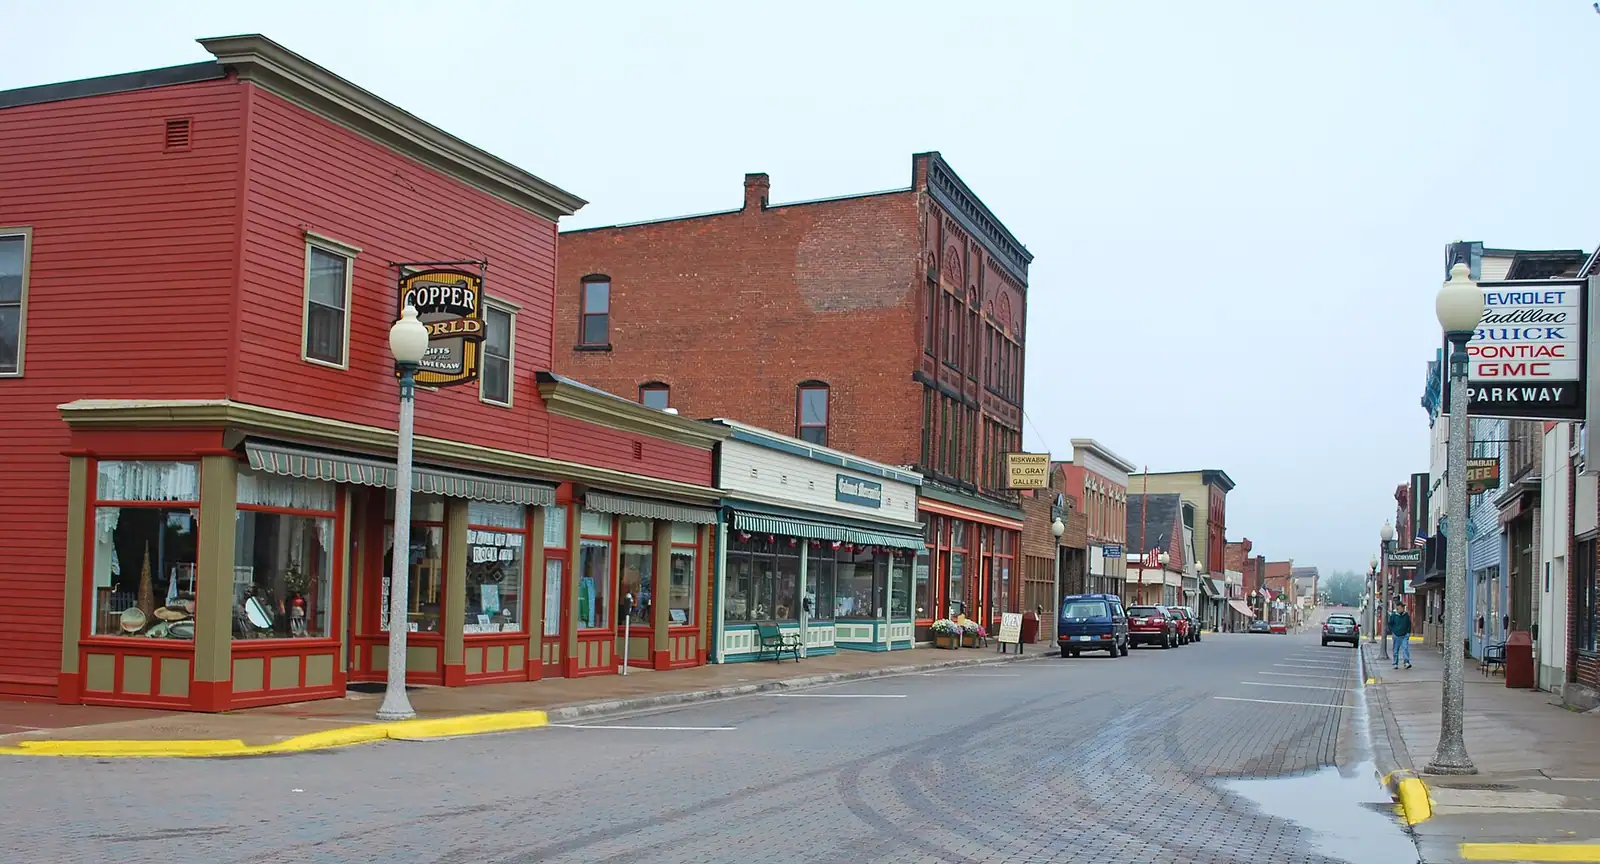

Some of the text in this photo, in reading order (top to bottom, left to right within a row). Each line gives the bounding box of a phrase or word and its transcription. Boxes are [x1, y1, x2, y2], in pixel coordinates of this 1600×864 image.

[405, 287, 474, 310] COPPER
[1484, 292, 1565, 305] EVROLET
[425, 320, 480, 335] ORLD
[1466, 345, 1564, 358] PONTIAC
[419, 360, 460, 369] WEENAW
[1478, 363, 1550, 376] GMC
[1466, 387, 1562, 401] PARKWAY
[1466, 467, 1492, 480] AFE
[474, 547, 497, 562] ROCK
